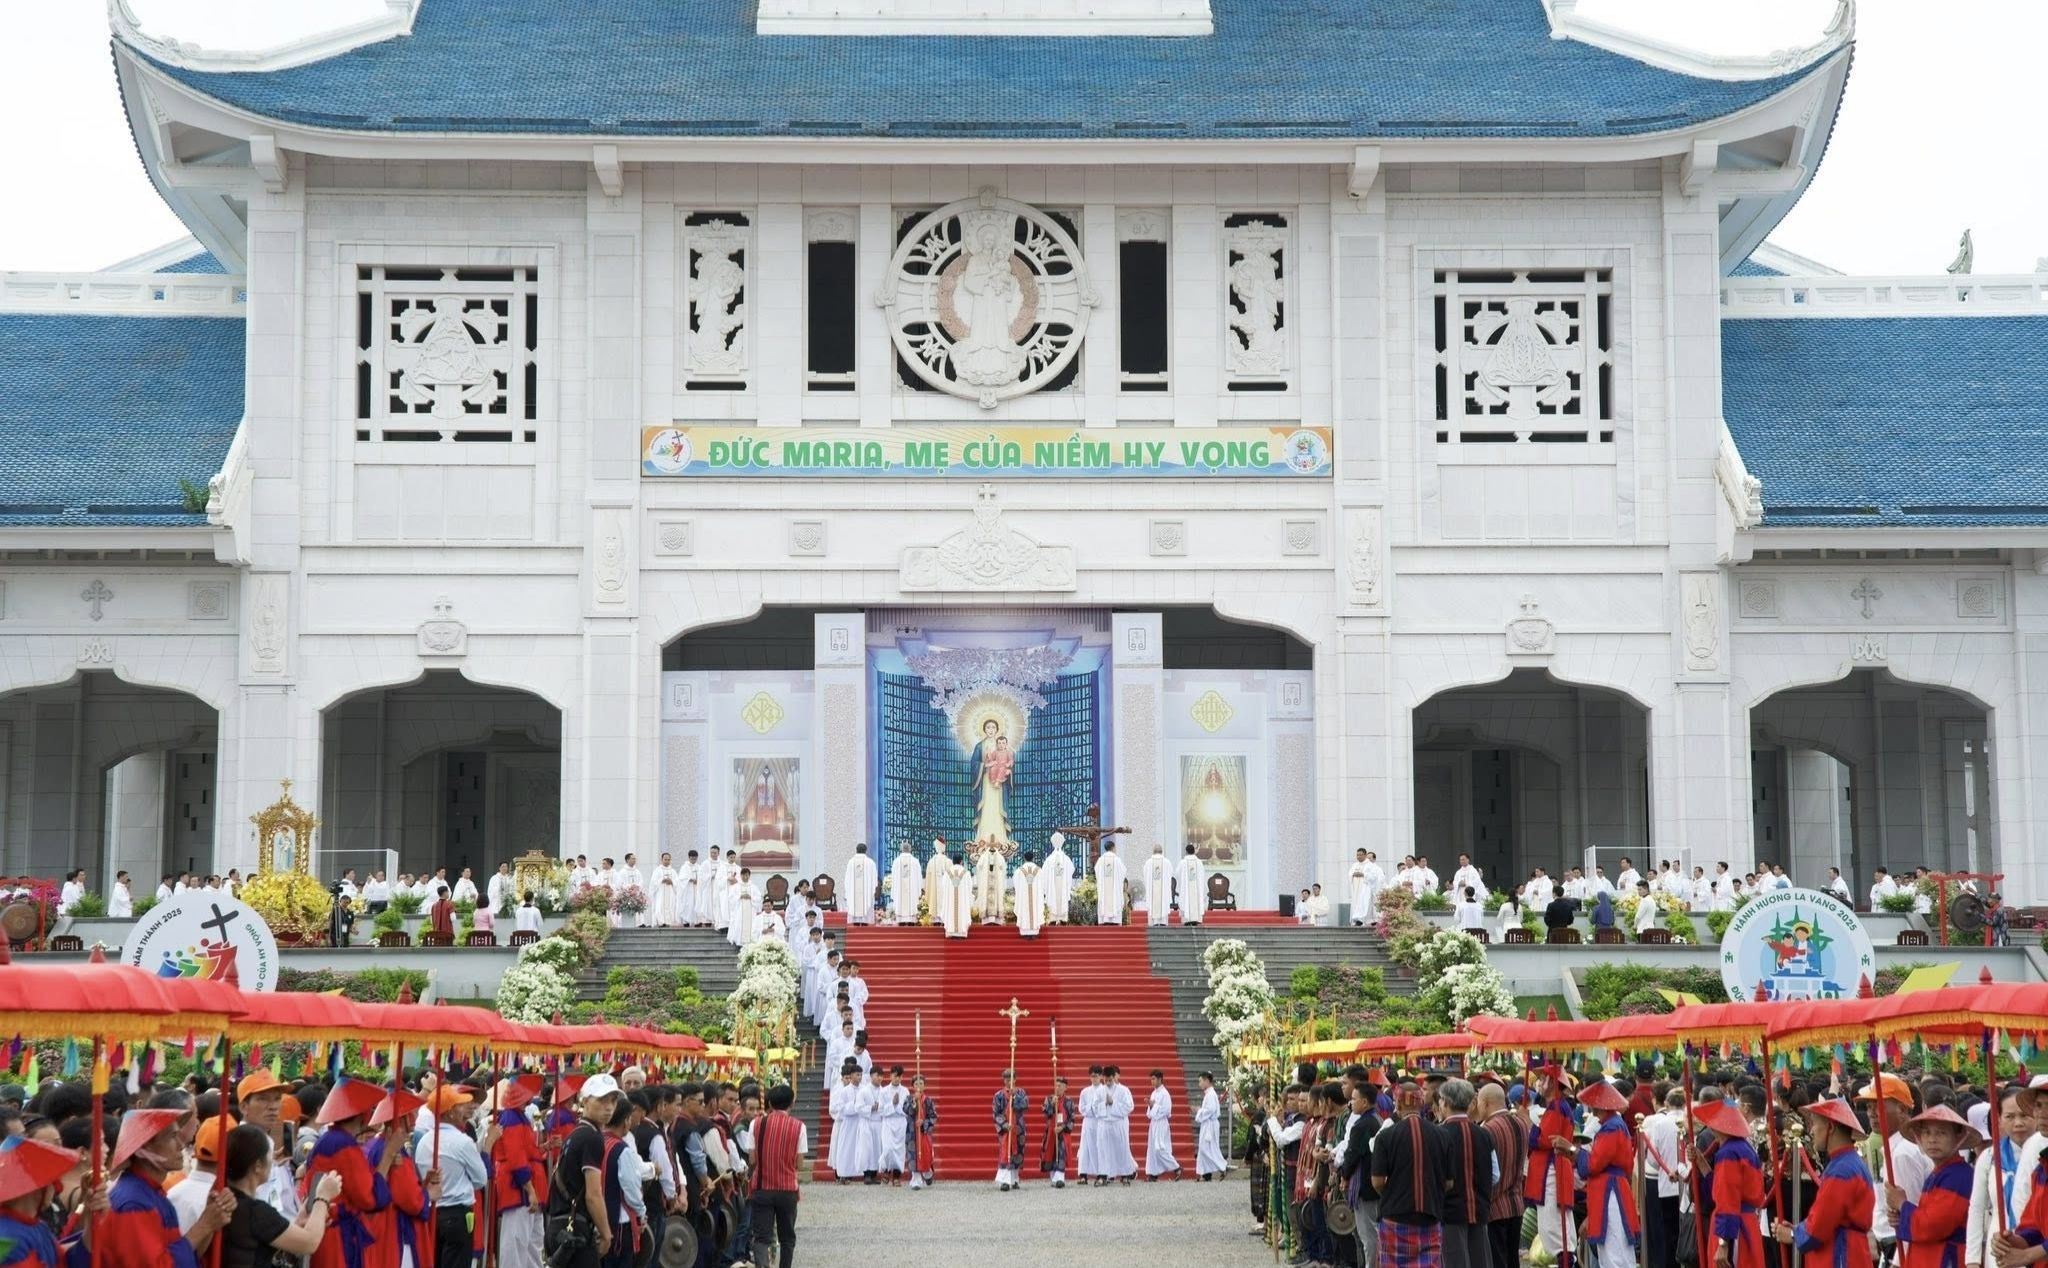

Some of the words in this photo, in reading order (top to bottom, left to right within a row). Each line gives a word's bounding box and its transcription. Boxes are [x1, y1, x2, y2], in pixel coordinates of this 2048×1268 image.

[708, 436, 770, 468] ĐỨC
[782, 442, 892, 471] MARIA,
[904, 442, 949, 474] MẸ
[963, 434, 1021, 468] CỦA
[1034, 432, 1111, 468] NIỀM
[1123, 442, 1165, 468] HY
[1180, 442, 1270, 474] VỌNG
[161, 907, 183, 923] 2025
[1794, 892, 1806, 901] LA
[1809, 894, 1837, 911] VANG
[1836, 910, 1858, 931] 2025
[257, 948, 266, 960] HY
